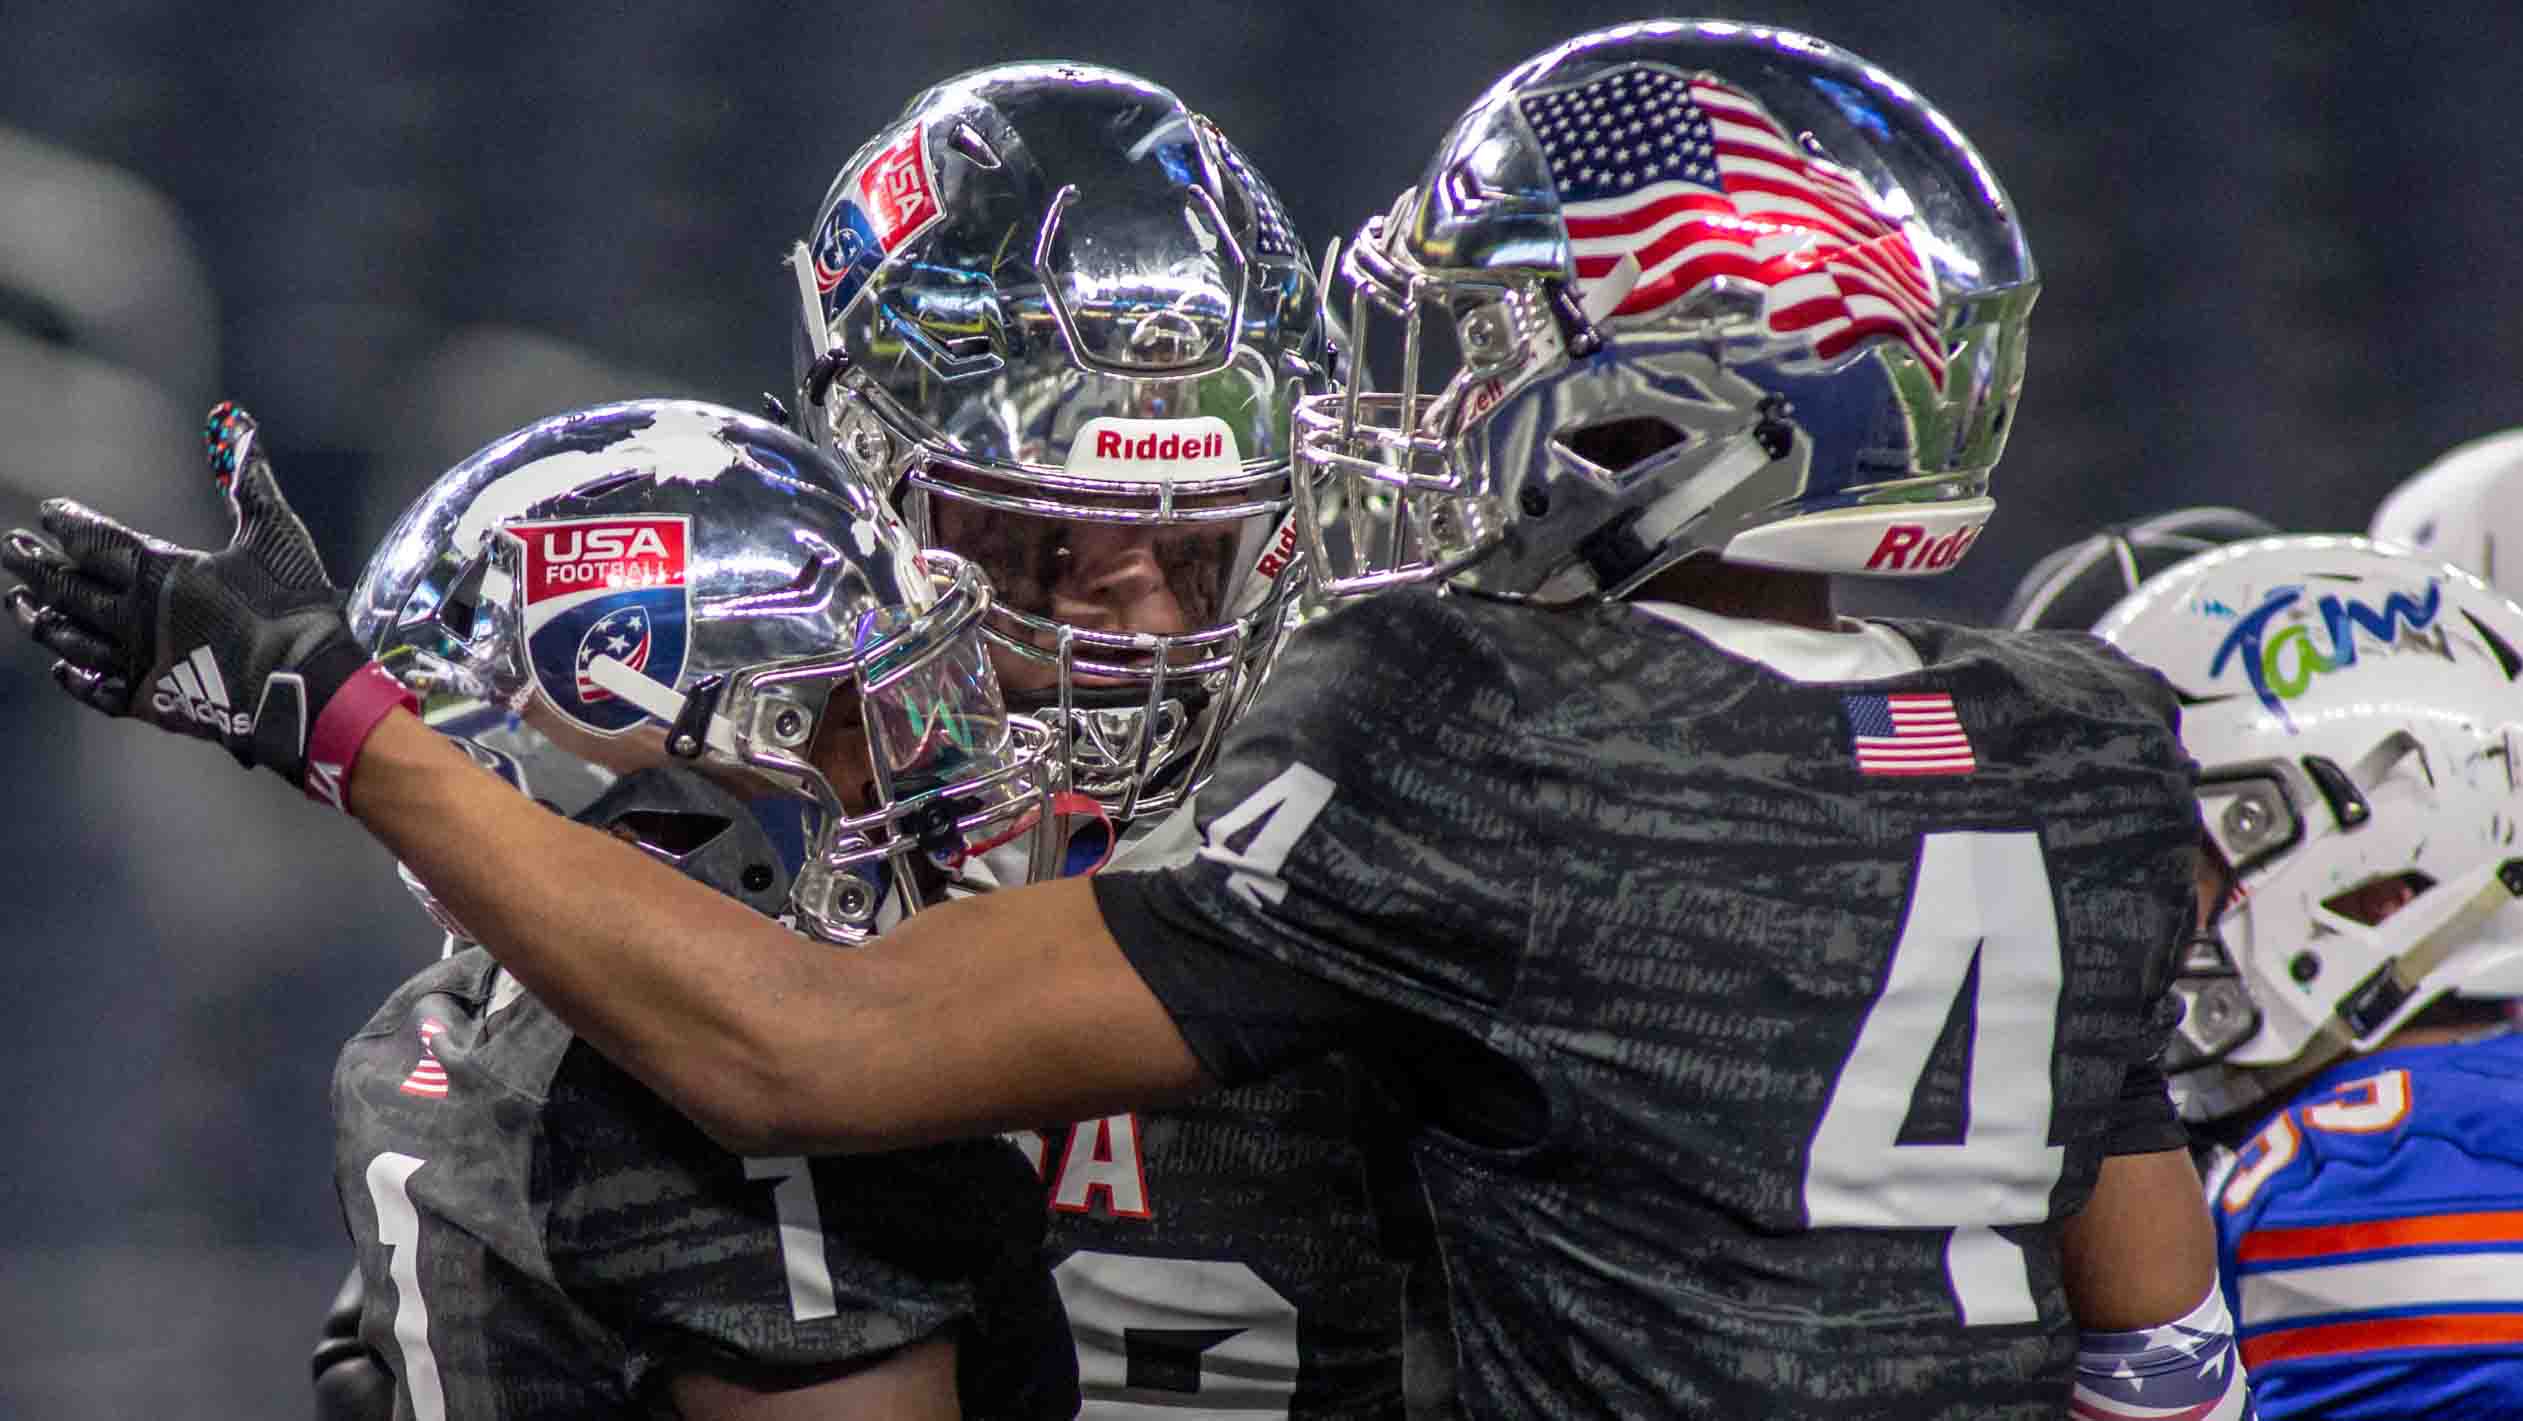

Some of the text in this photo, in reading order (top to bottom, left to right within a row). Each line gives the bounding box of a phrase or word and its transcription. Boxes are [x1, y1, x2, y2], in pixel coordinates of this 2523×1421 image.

[1096, 430, 1222, 460] Riddell
[544, 527, 669, 562] USA
[545, 560, 670, 588] FOOTBALL
[1256, 510, 1296, 578] Rid
[1200, 762, 1336, 908] 4
[1803, 830, 2065, 1327] 4
[366, 1152, 446, 1421] 1
[744, 1156, 837, 1321] 1
